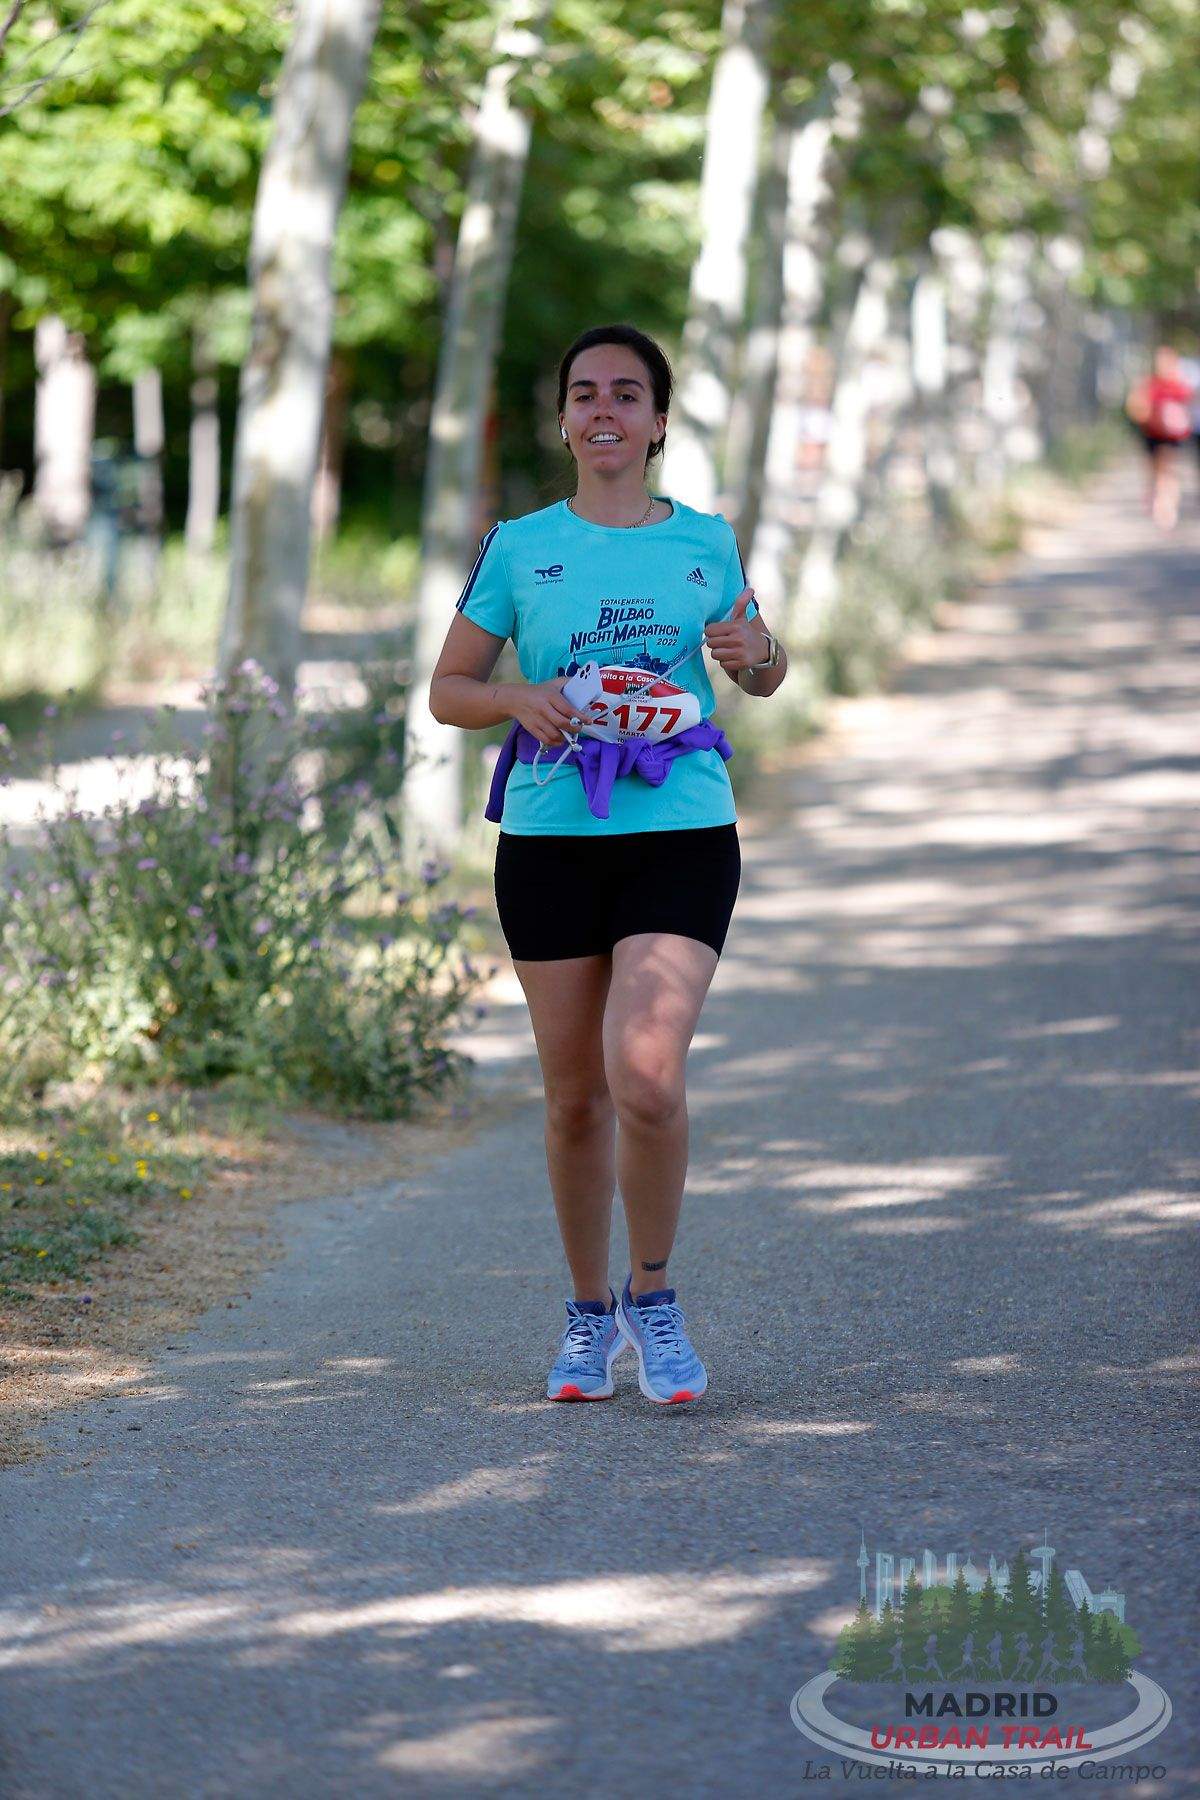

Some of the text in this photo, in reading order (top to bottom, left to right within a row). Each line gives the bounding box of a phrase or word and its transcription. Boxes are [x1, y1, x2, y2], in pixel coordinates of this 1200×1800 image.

[686, 576, 708, 588] adidas
[597, 607, 654, 630] BILBAO
[656, 637, 678, 647] 2022
[589, 701, 682, 734] 2177
[618, 730, 646, 738] MARTA
